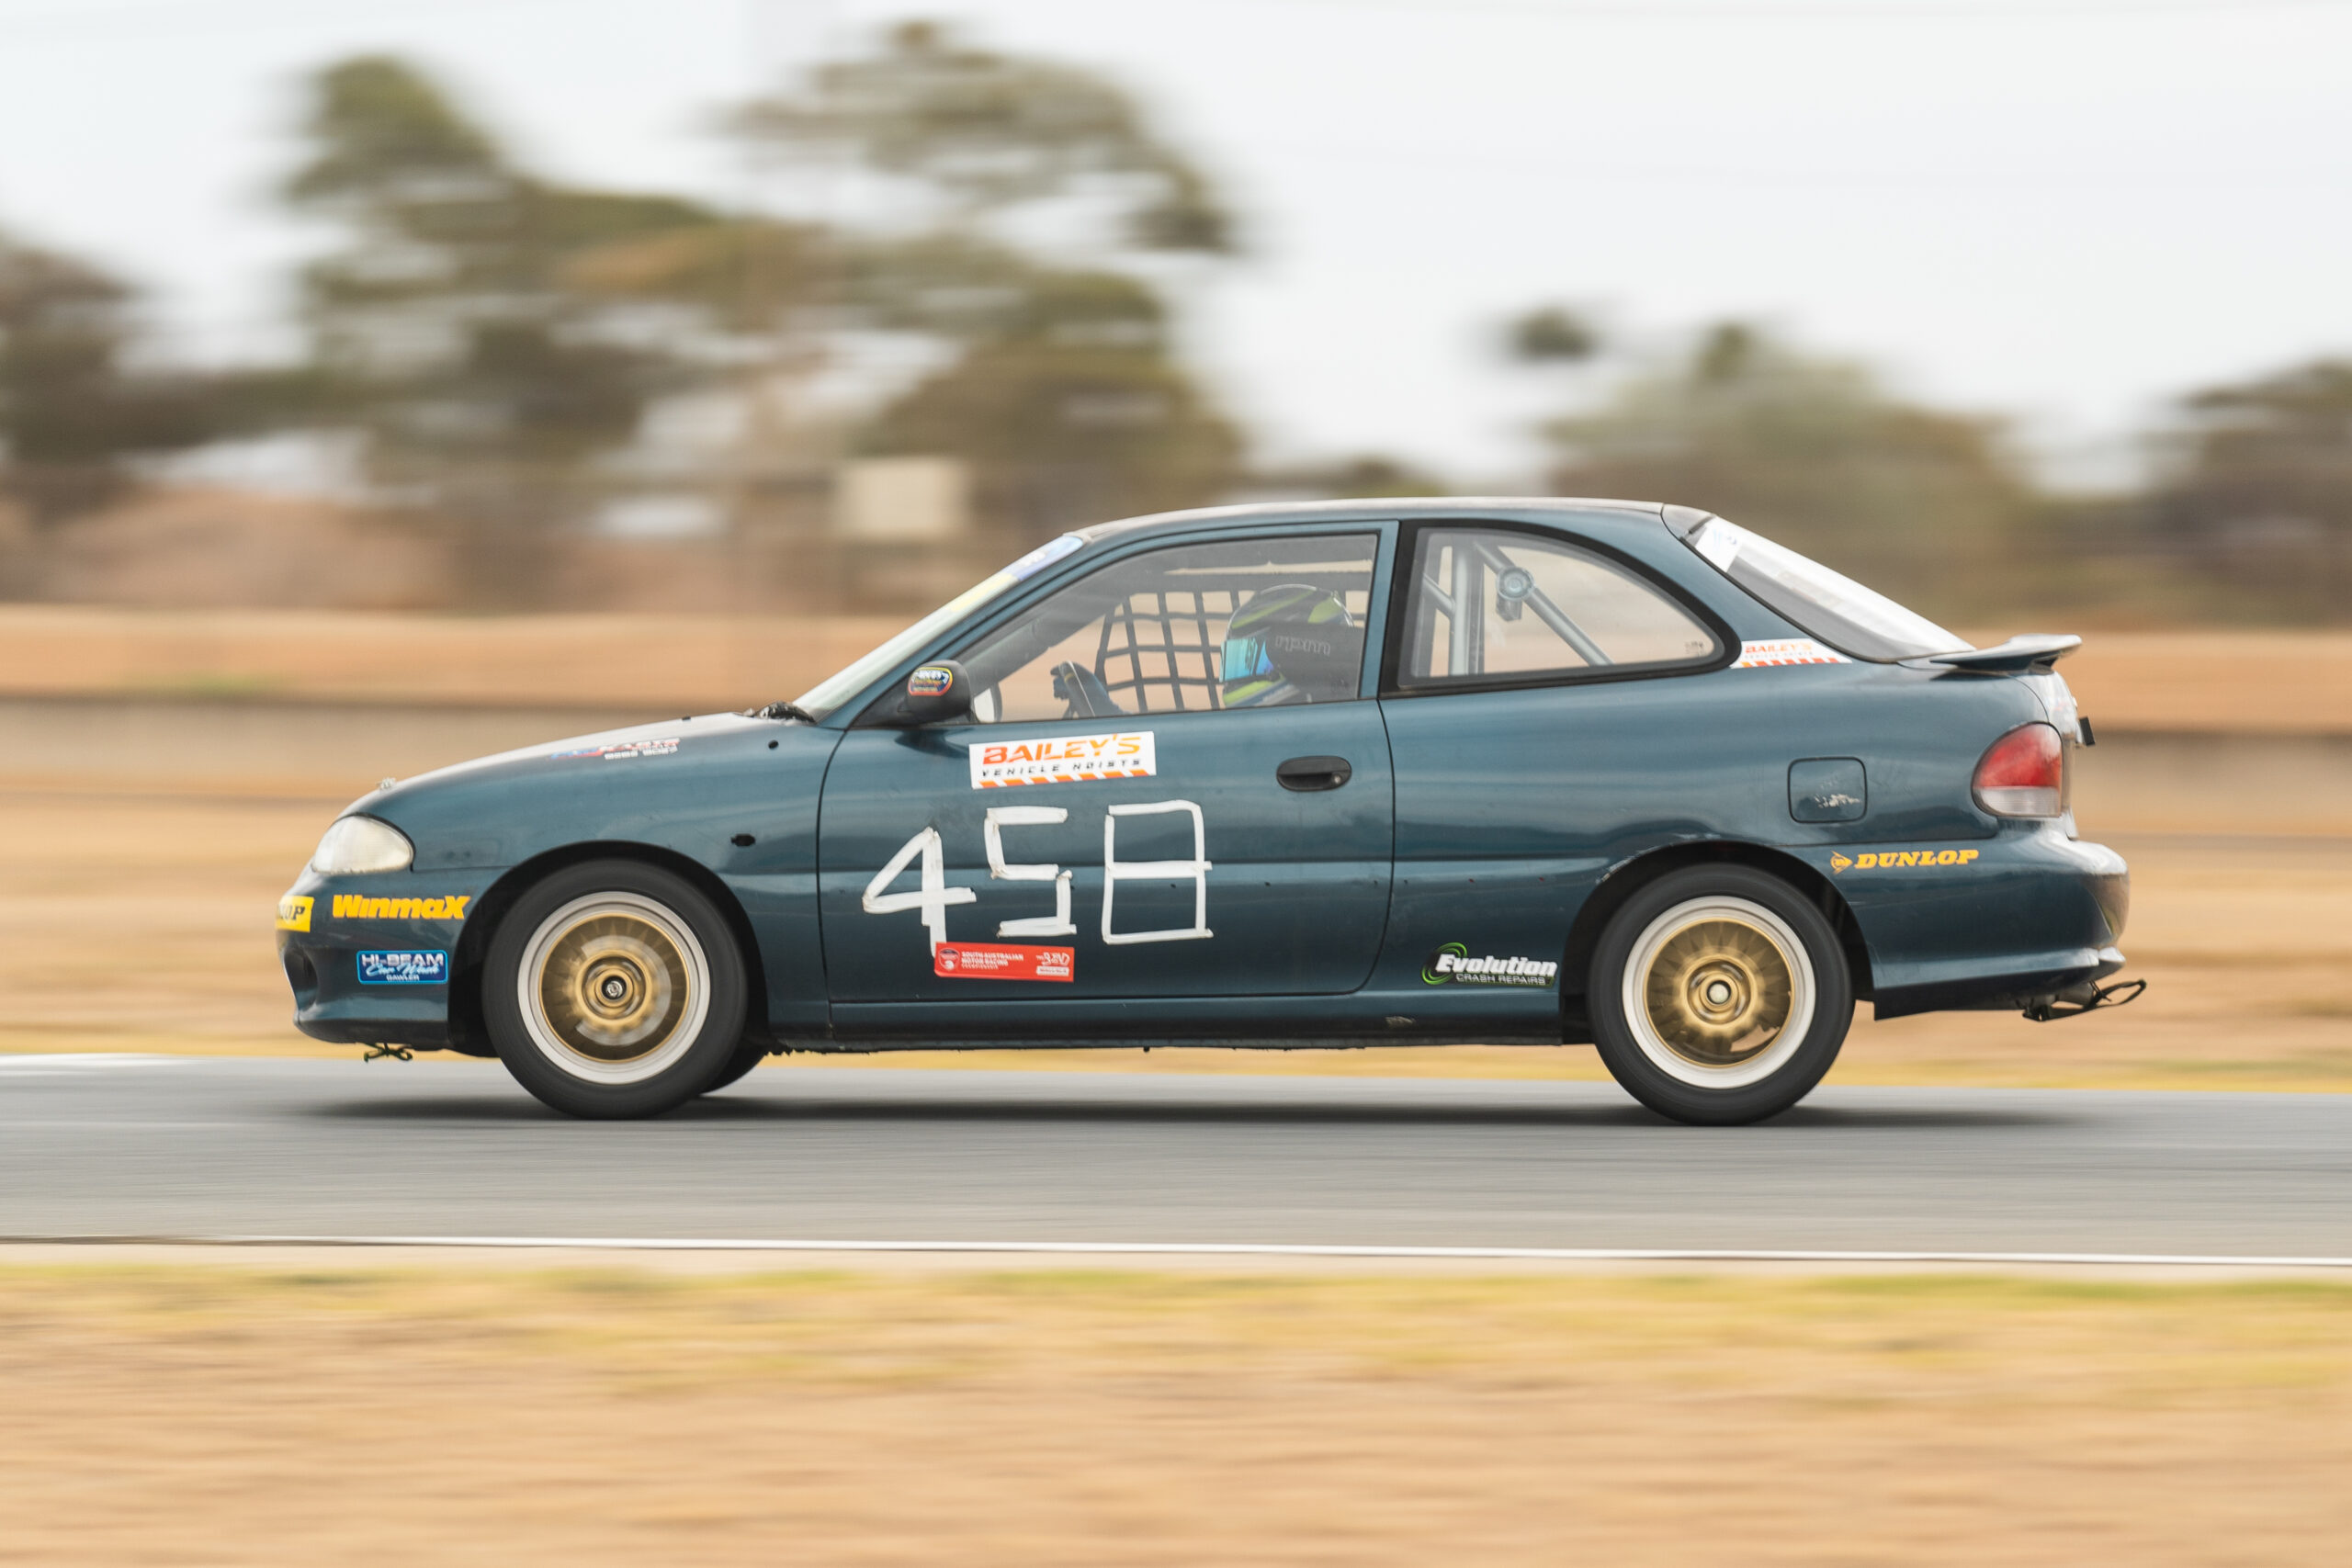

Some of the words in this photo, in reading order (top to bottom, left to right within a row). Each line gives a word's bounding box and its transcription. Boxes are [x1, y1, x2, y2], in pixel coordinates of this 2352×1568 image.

[982, 733, 1141, 764] BAILEY'S
[1854, 850, 1979, 869] DUNLOP
[361, 953, 444, 966] HI-BEAM
[1435, 953, 1558, 976] Evolution
[1455, 973, 1496, 983] CRASH
[1498, 975, 1546, 986] REPAIRS
